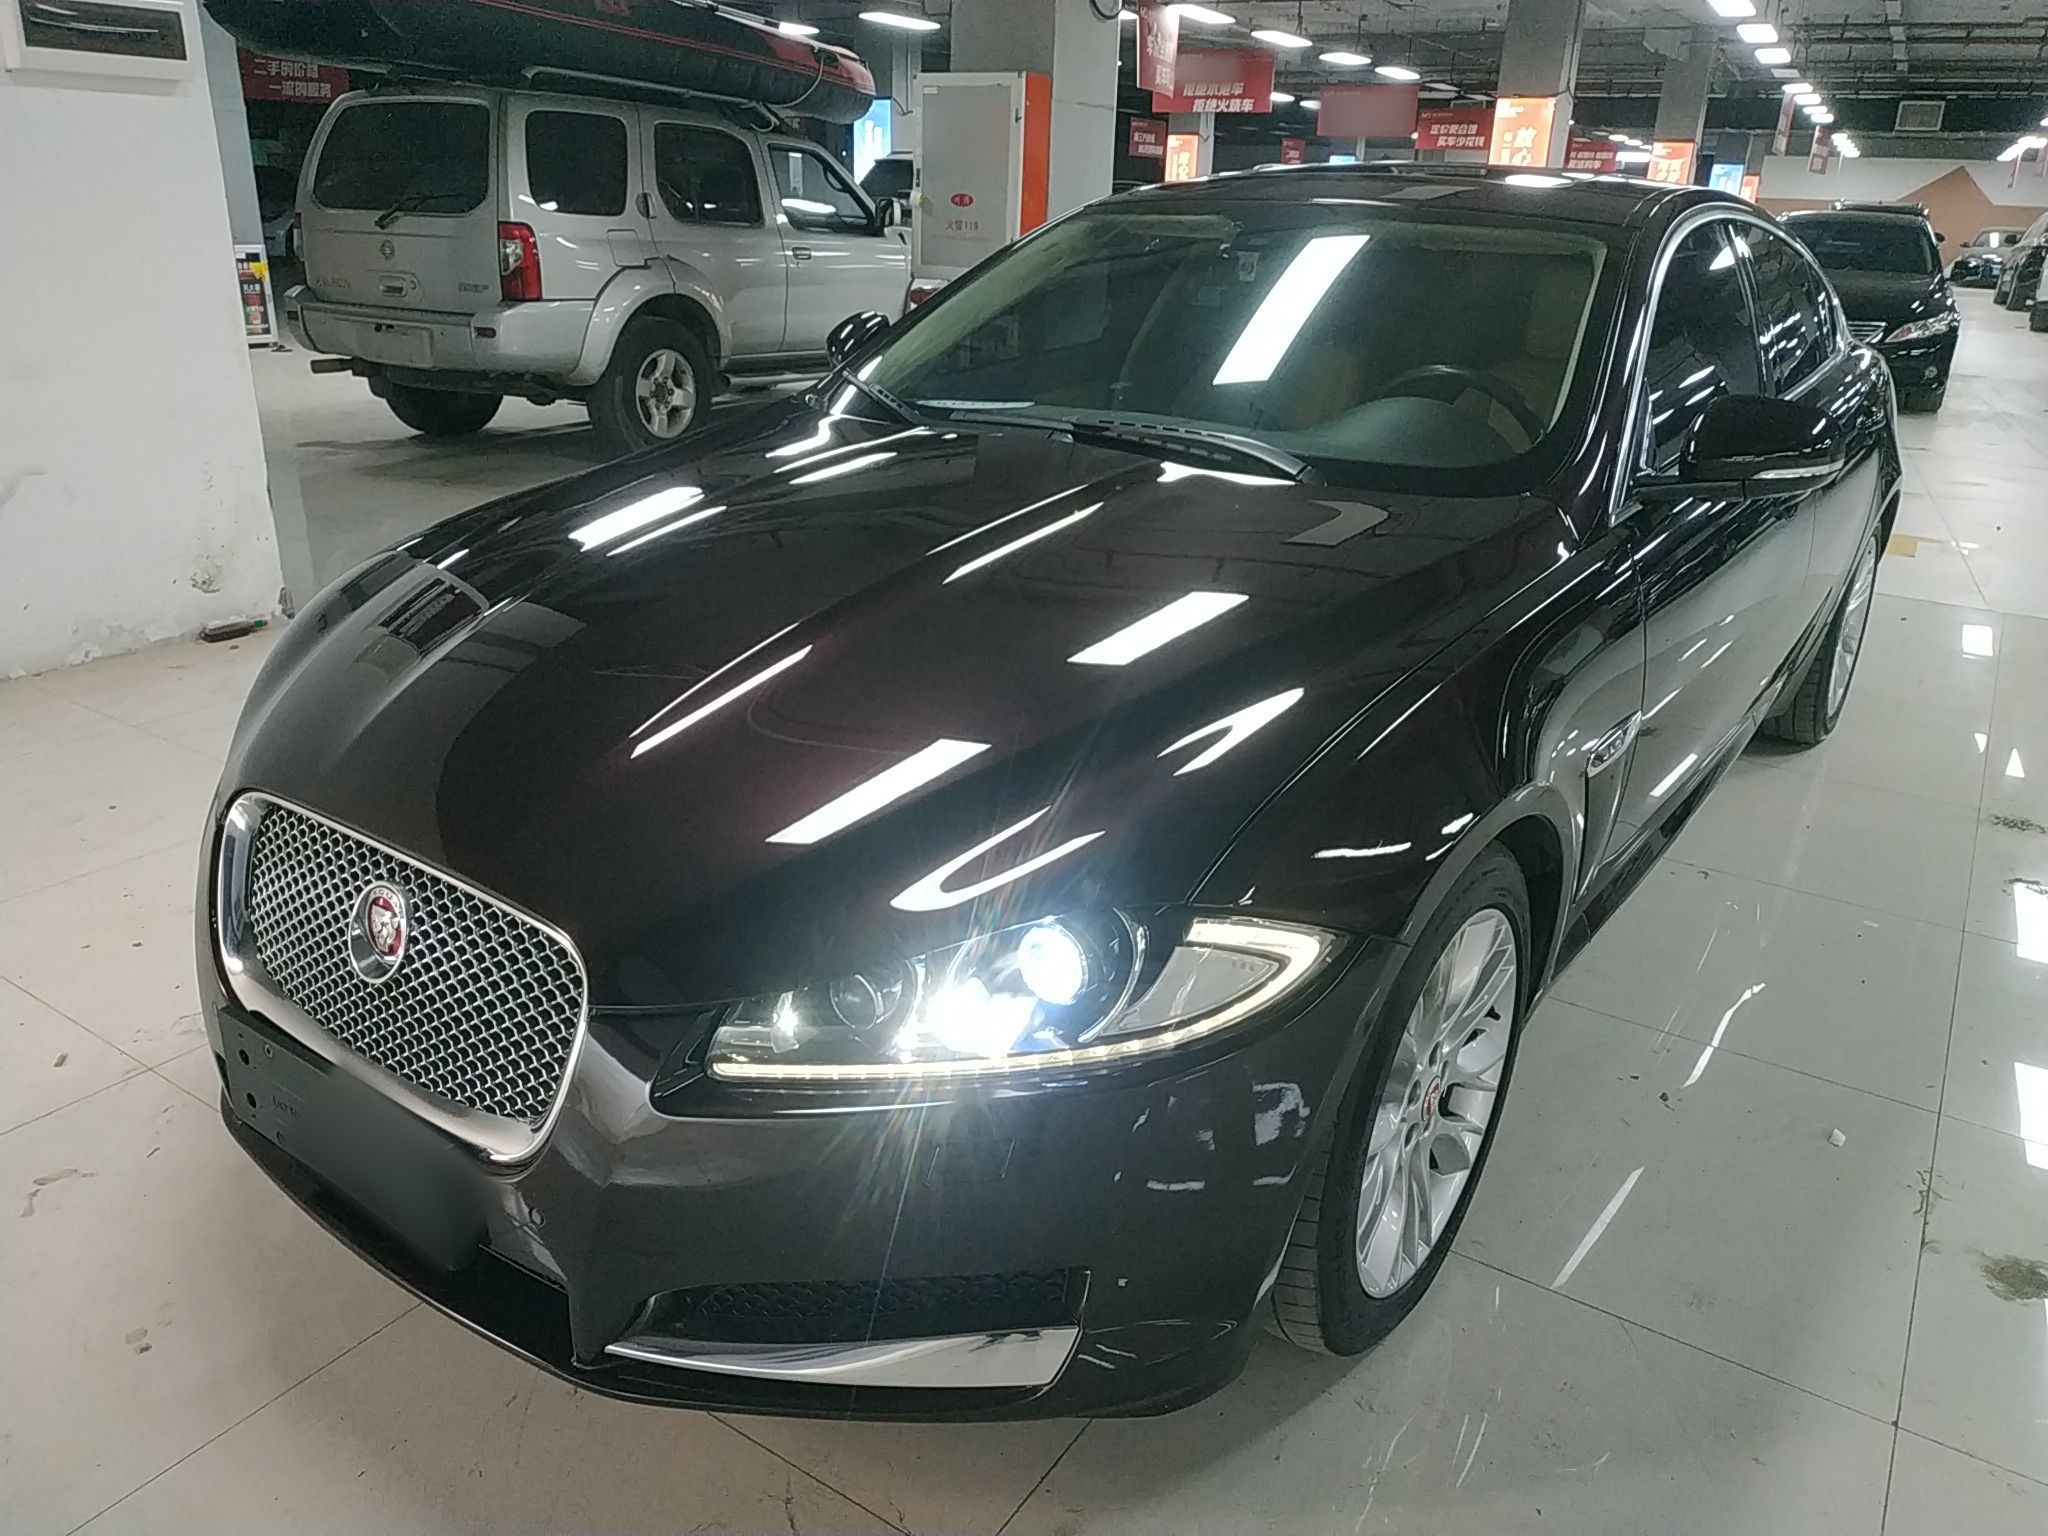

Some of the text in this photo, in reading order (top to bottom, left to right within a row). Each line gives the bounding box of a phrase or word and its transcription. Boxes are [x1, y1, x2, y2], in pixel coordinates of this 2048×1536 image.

[1193, 98, 1255, 113] 拒绝火烧车
